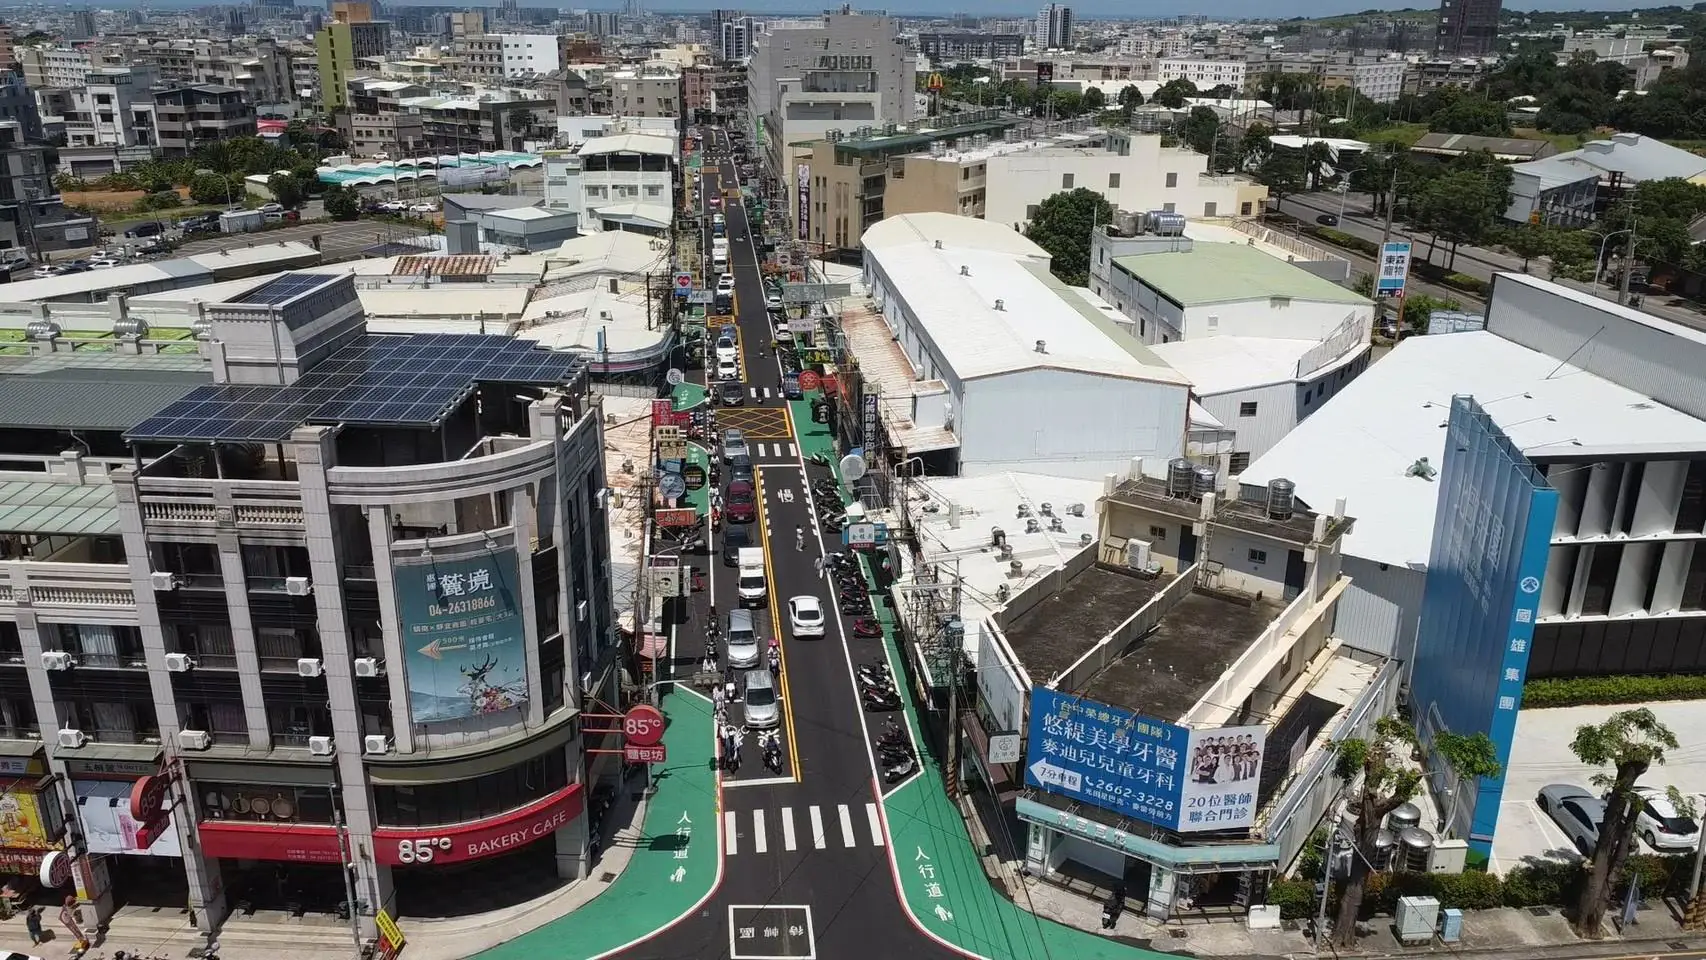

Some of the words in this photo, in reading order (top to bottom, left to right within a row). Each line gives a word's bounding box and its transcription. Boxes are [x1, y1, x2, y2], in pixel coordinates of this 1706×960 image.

[1385, 255, 1406, 265] 東森
[777, 488, 795, 504] 慢
[438, 569, 494, 599] 麓境
[429, 596, 495, 617] 04-26318866
[1498, 608, 1532, 711] 國雄集團
[1042, 712, 1179, 771] 悠緹美學牙醫
[627, 747, 663, 762] 麵包坊
[1041, 738, 1175, 792] 麥迪兒兒童牙科
[1039, 766, 1078, 787] 7分車程
[1097, 779, 1174, 811] 2662-3228
[1188, 793, 1253, 808] 20位醫師
[1188, 807, 1249, 823] 聯合門診
[467, 826, 529, 857] BAKERY
[532, 809, 568, 839] CAFE
[672, 810, 692, 860] 人行道
[915, 846, 944, 899] 人行道
[739, 925, 804, 940] 待轉區
